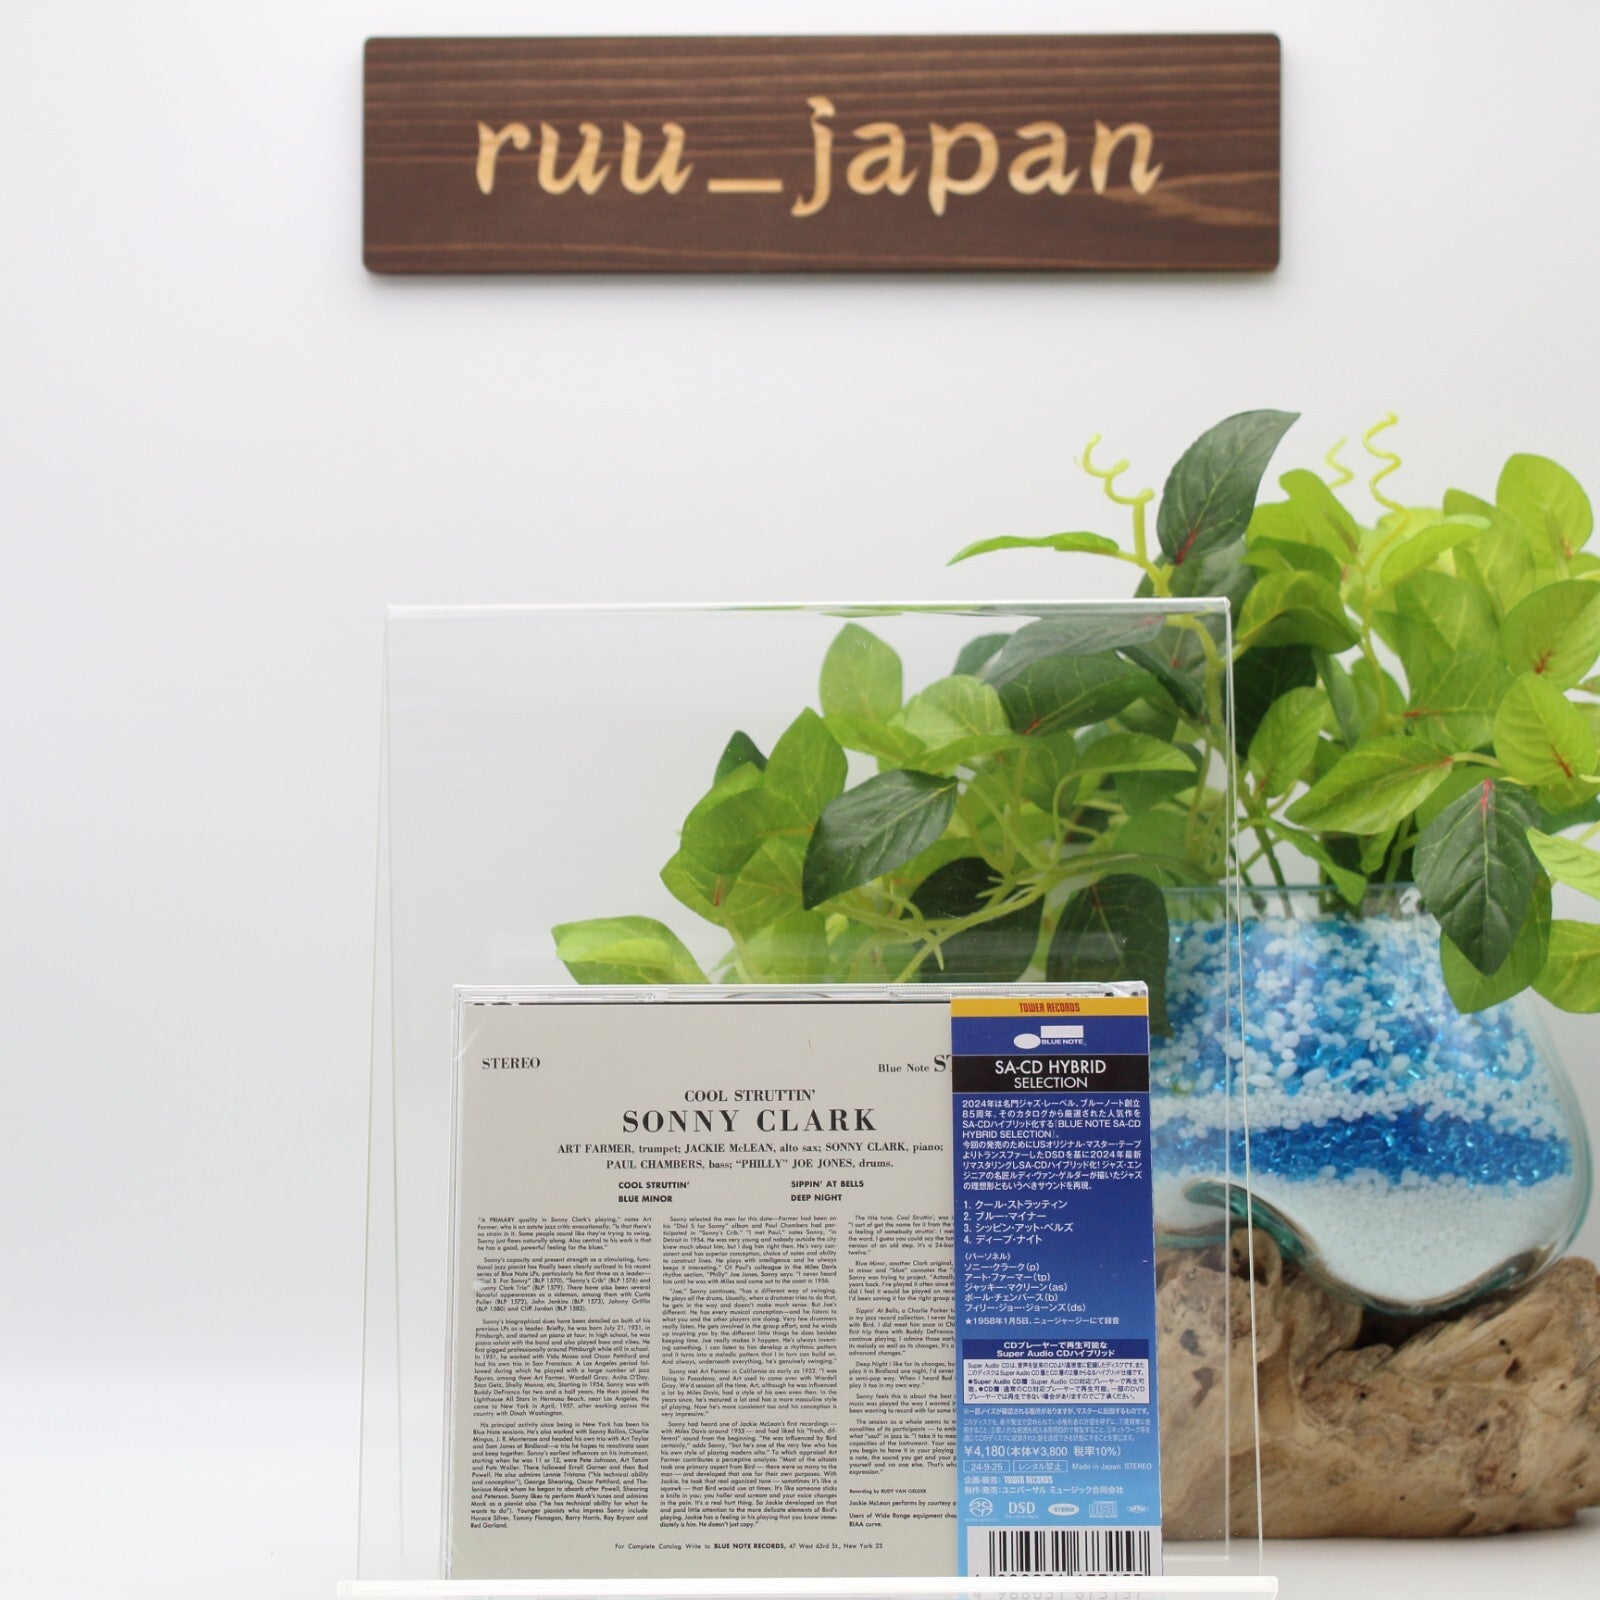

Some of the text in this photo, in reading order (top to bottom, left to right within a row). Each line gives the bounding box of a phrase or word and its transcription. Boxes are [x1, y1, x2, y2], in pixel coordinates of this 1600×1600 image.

[477, 97, 1159, 216] ruu_japan
[1019, 1002, 1080, 1013] TOWER RECORDS
[482, 1057, 541, 1069] STEREO
[878, 1064, 902, 1072] Blue
[907, 1063, 929, 1072] Note
[995, 1060, 1106, 1074] SA-CD HYBRID
[1014, 1076, 1088, 1089] SELECTION
[684, 1089, 815, 1102] COOL STRUTTIN’
[623, 1109, 877, 1133] SONNY CLARK
[1085, 1119, 1111, 1128] NOTE
[1113, 1119, 1141, 1128] SA-CD
[962, 1130, 998, 1139] HYBRID
[557, 1144, 581, 1153] ART
[585, 1144, 635, 1154] FARMER,
[639, 1145, 681, 1156] trumpet;
[684, 1143, 725, 1154] JACKIE
[729, 1143, 776, 1153] McLEAN,
[779, 1143, 799, 1152] alto
[826, 1142, 863, 1152] SONNY
[867, 1142, 909, 1152] CLARK,
[913, 1142, 943, 1154] piano;
[606, 1158, 893, 1169] PAUL CHAMBERS, bass; “PHILLY” JOE JONES, drums.
[618, 1181, 689, 1189] COOL STRUTTIN’
[791, 1180, 822, 1188] SIPPIN’
[840, 1180, 864, 1188] BELLS
[618, 1195, 673, 1203] BLUE MINOR
[791, 1194, 811, 1202] DEEP
[964, 1200, 971, 1209] 1.
[963, 1211, 972, 1221] 2.
[963, 1223, 972, 1233] 3.
[963, 1235, 972, 1244] 4.
[997, 1350, 1025, 1358] Super
[1072, 1462, 1091, 1470] Made
[1100, 1463, 1121, 1471] Japan
[1124, 1462, 1152, 1470] STEREO
[1008, 1501, 1036, 1515] DSD
[892, 1512, 911, 1520] Range
